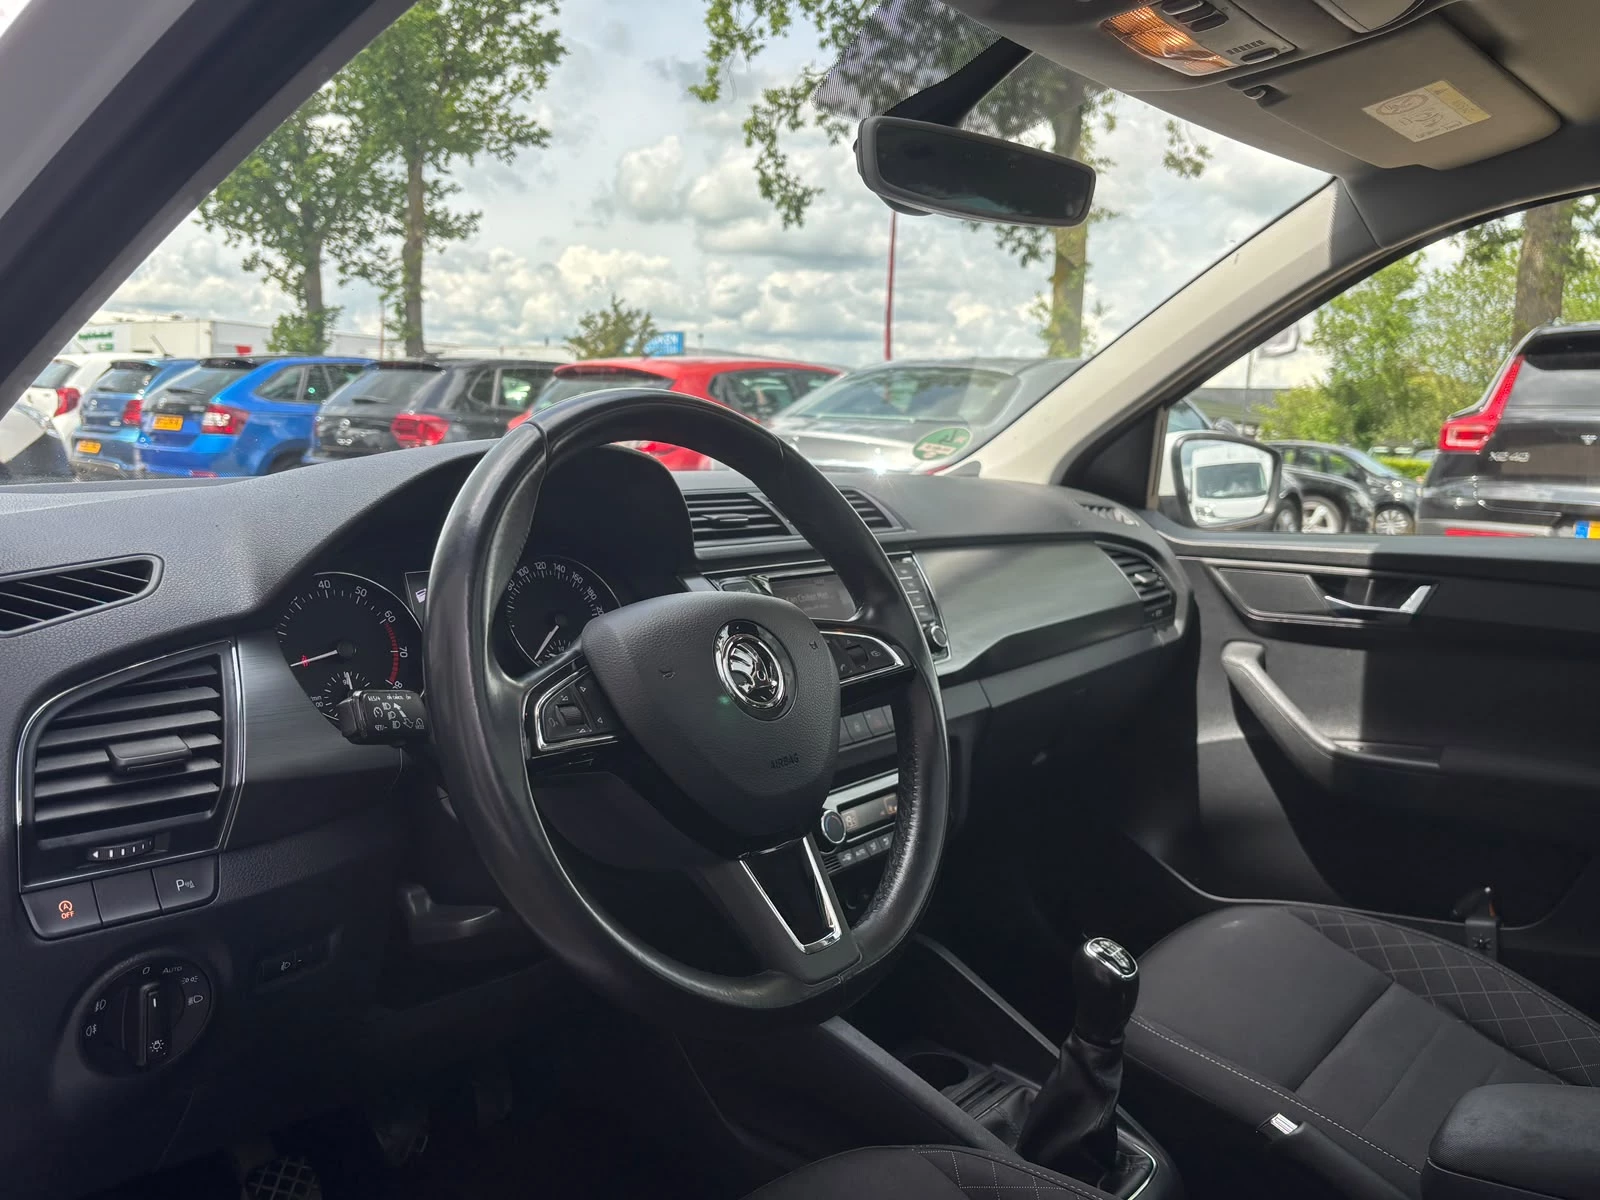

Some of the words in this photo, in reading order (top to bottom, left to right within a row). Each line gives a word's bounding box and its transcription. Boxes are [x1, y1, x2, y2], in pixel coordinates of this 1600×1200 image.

[517, 566, 529, 577] 100
[534, 561, 547, 571] 120
[553, 563, 566, 574] 140
[572, 571, 583, 584] 160
[318, 579, 331, 589] 40
[354, 586, 368, 597] 50
[586, 586, 597, 600] 180
[385, 610, 396, 623] 60
[399, 646, 408, 658] 70
[769, 752, 800, 768] AIRBAG
[175, 879, 185, 892] P
[60, 910, 74, 920] OFF
